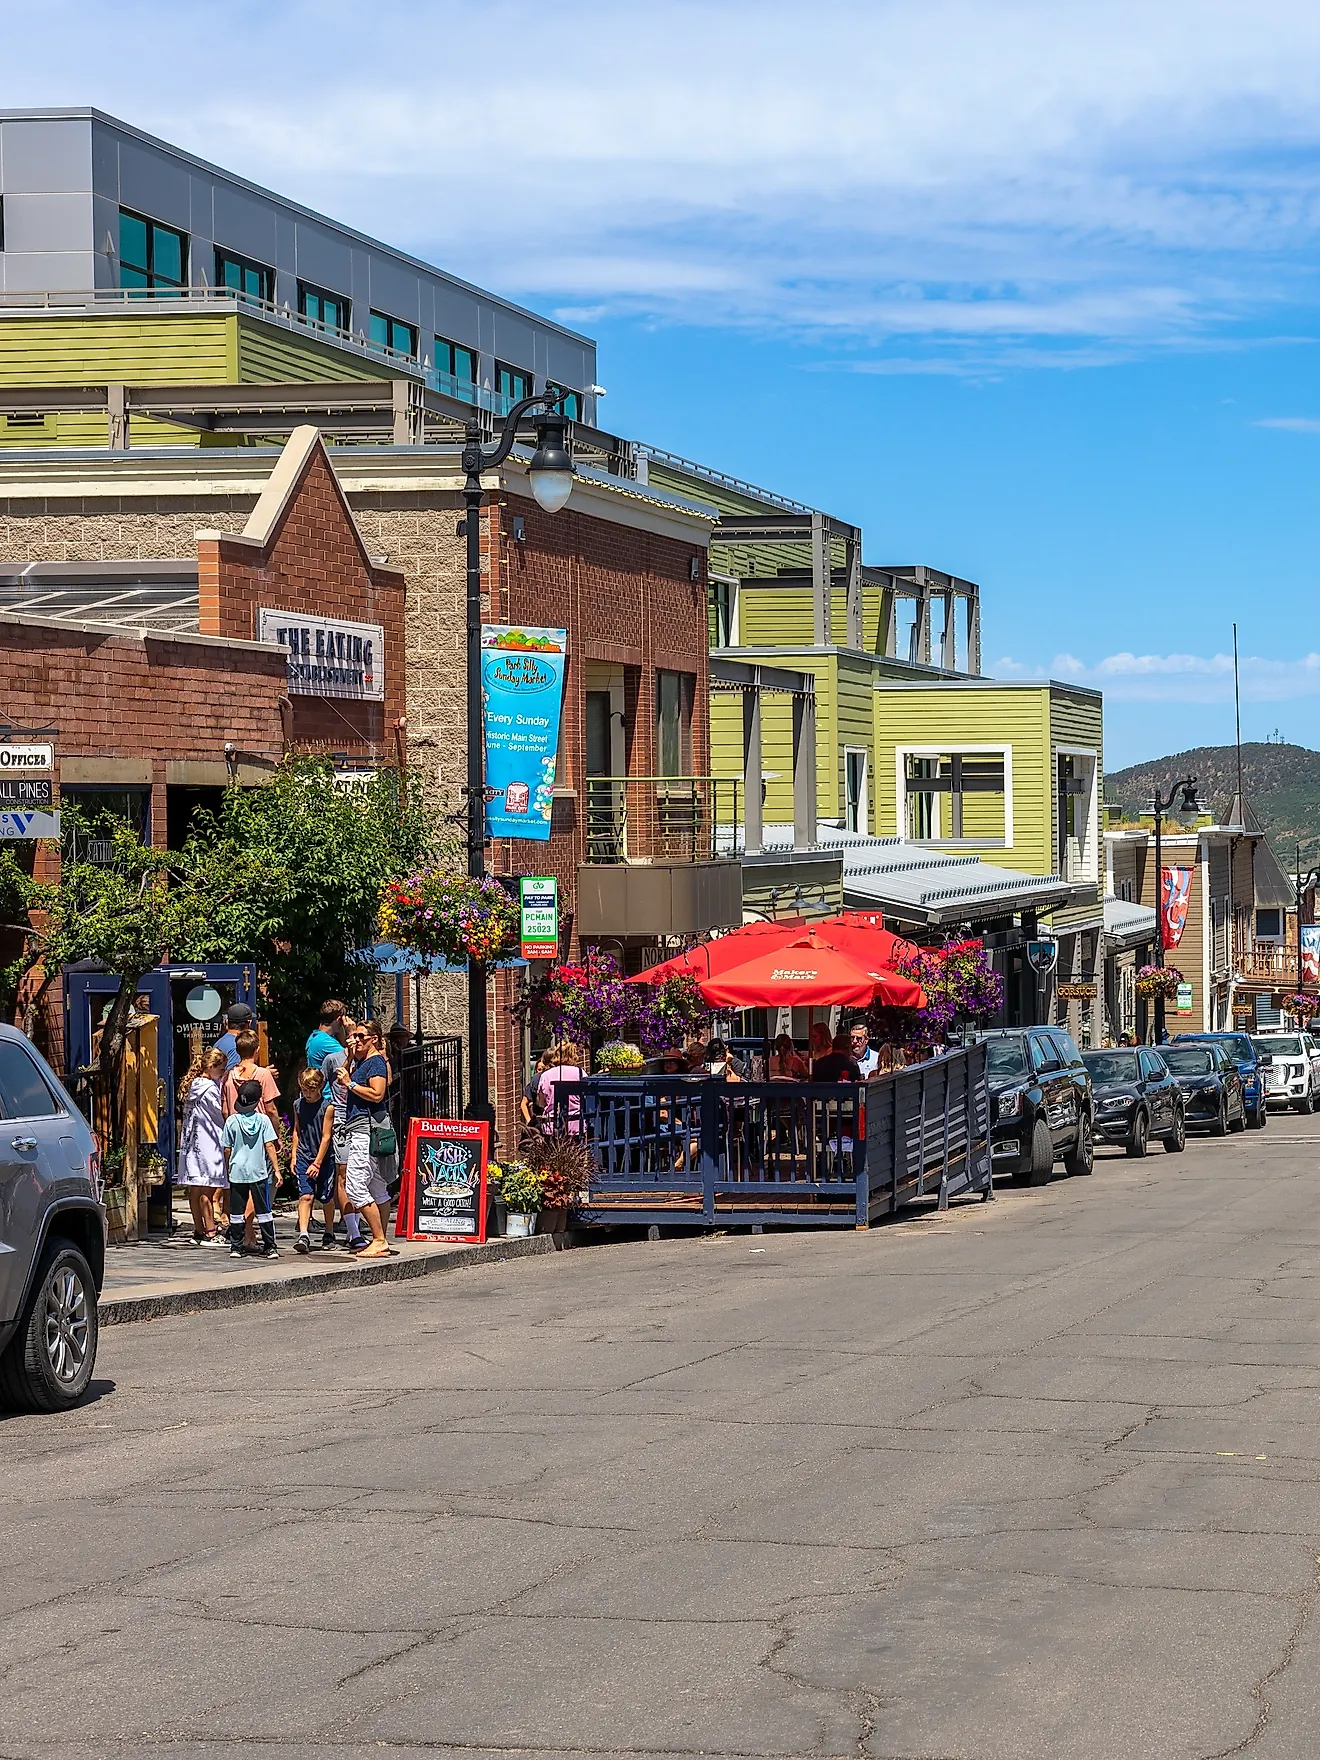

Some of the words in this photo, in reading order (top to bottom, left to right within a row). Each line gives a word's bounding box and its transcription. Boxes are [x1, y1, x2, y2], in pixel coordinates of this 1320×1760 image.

[276, 627, 310, 655] THE
[315, 628, 373, 666] EATING
[505, 658, 521, 670] Park
[522, 657, 538, 675] Silly
[493, 666, 520, 687] Sunday
[520, 671, 547, 685] Market
[487, 711, 513, 726] Every
[515, 714, 550, 728] Sunday
[486, 730, 511, 741] Historic
[511, 733, 527, 742] Main
[528, 733, 548, 744] Street
[507, 742, 547, 753] September
[18, 782, 49, 799] PINES
[525, 913, 553, 921] PCMAIN
[527, 925, 552, 933] 25023
[1057, 987, 1098, 996] GORSUCH
[420, 1120, 480, 1134] Budweiser
[434, 1146, 463, 1164] FISH
[429, 1159, 468, 1183] TACOS
[422, 1196, 437, 1206] WHAT
[437, 1198, 443, 1207] A
